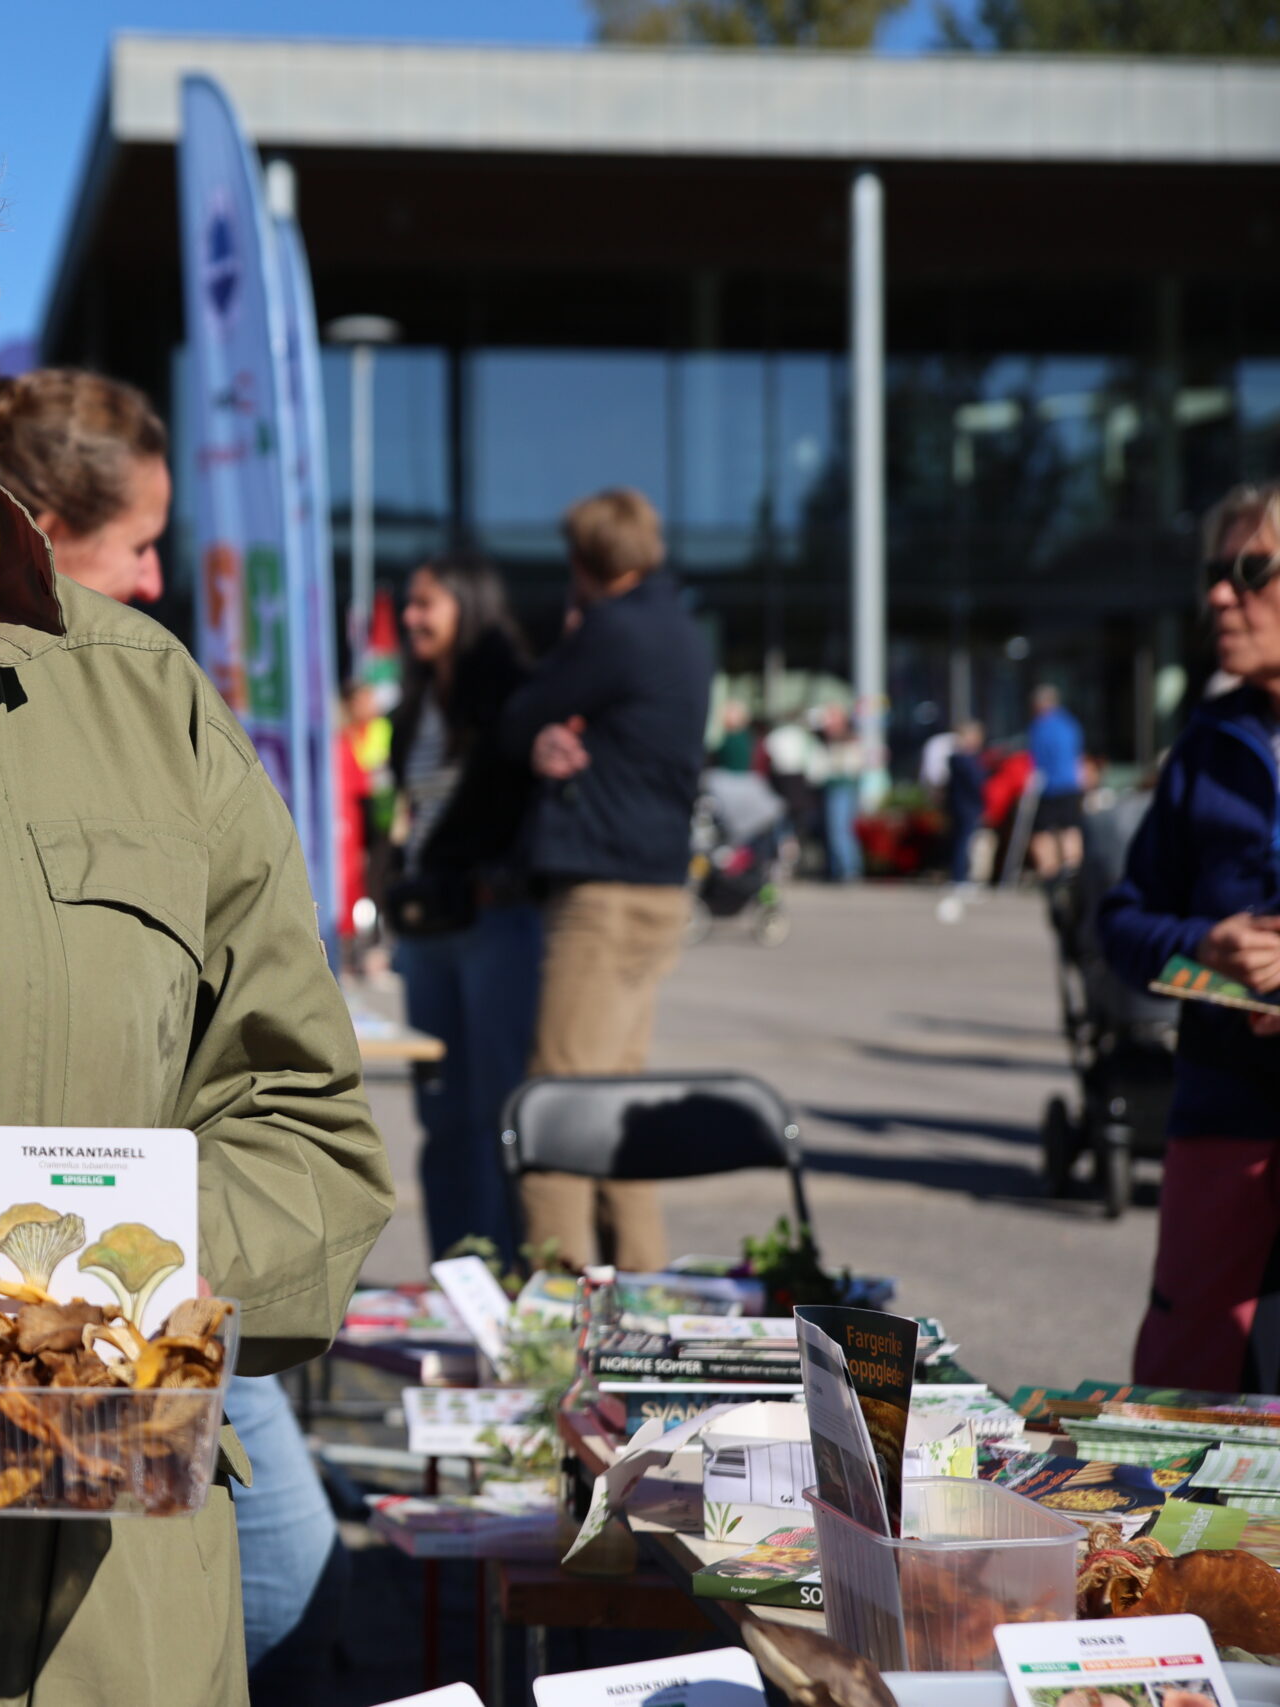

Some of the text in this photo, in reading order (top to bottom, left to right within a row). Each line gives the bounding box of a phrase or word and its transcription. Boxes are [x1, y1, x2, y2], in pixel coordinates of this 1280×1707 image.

[21, 1145, 145, 1158] TRAKTKANTARELL
[62, 1175, 104, 1184] SPISELIG
[847, 1325, 903, 1357] Fargerike
[599, 1356, 653, 1372] NORSKE
[655, 1358, 702, 1375] SOPPER
[847, 1359, 905, 1388] oppgleder
